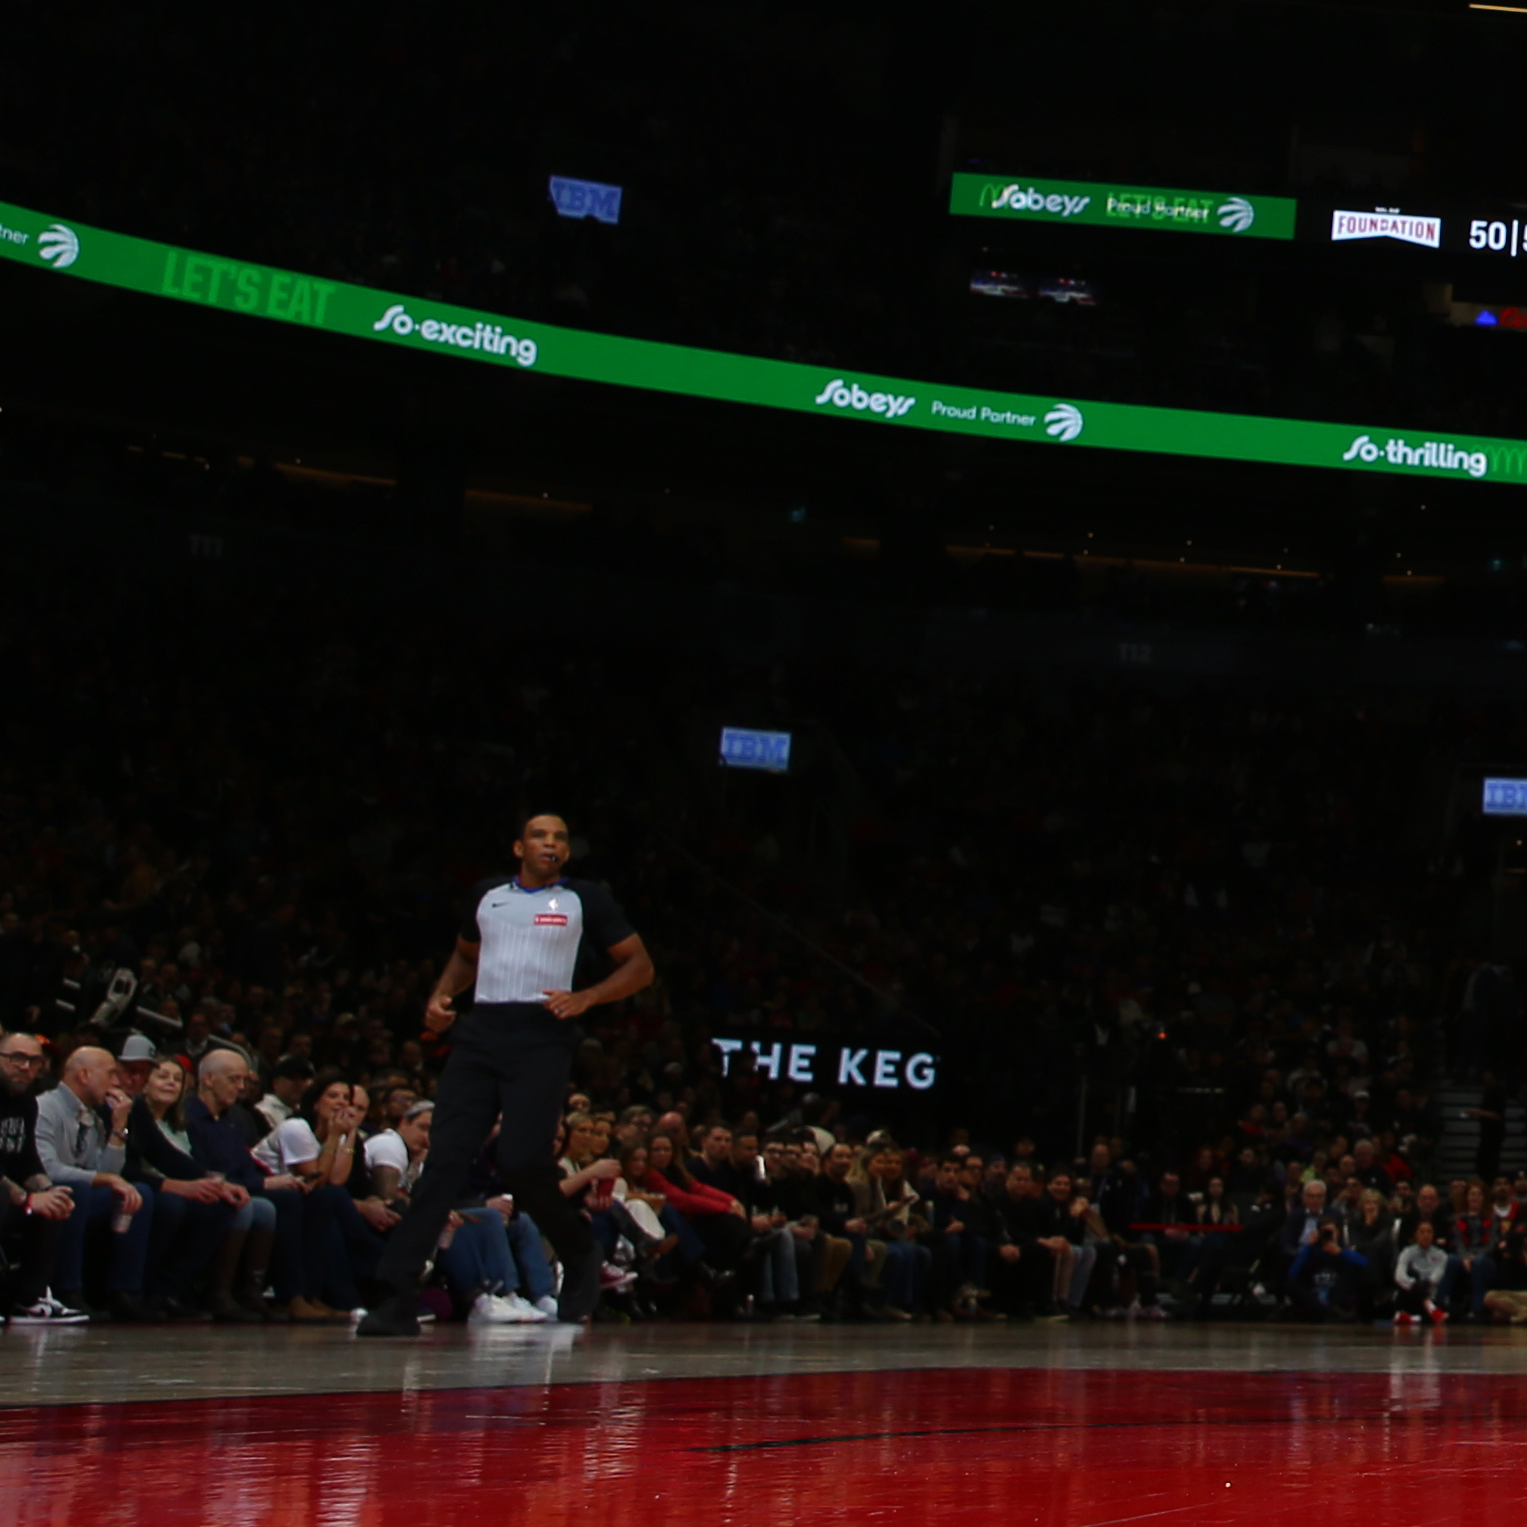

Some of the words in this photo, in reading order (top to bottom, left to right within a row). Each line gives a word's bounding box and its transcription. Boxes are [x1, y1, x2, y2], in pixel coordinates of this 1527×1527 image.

[990, 182, 1092, 219] Sobeys
[1336, 215, 1437, 242] FOUNDATION
[266, 268, 335, 327] EAT
[815, 378, 916, 419] Sobeys
[931, 399, 977, 422] Proud
[980, 405, 1037, 428] Partner
[723, 733, 788, 767] IBM
[711, 1038, 816, 1081] THE
[838, 1047, 936, 1090] KEG
